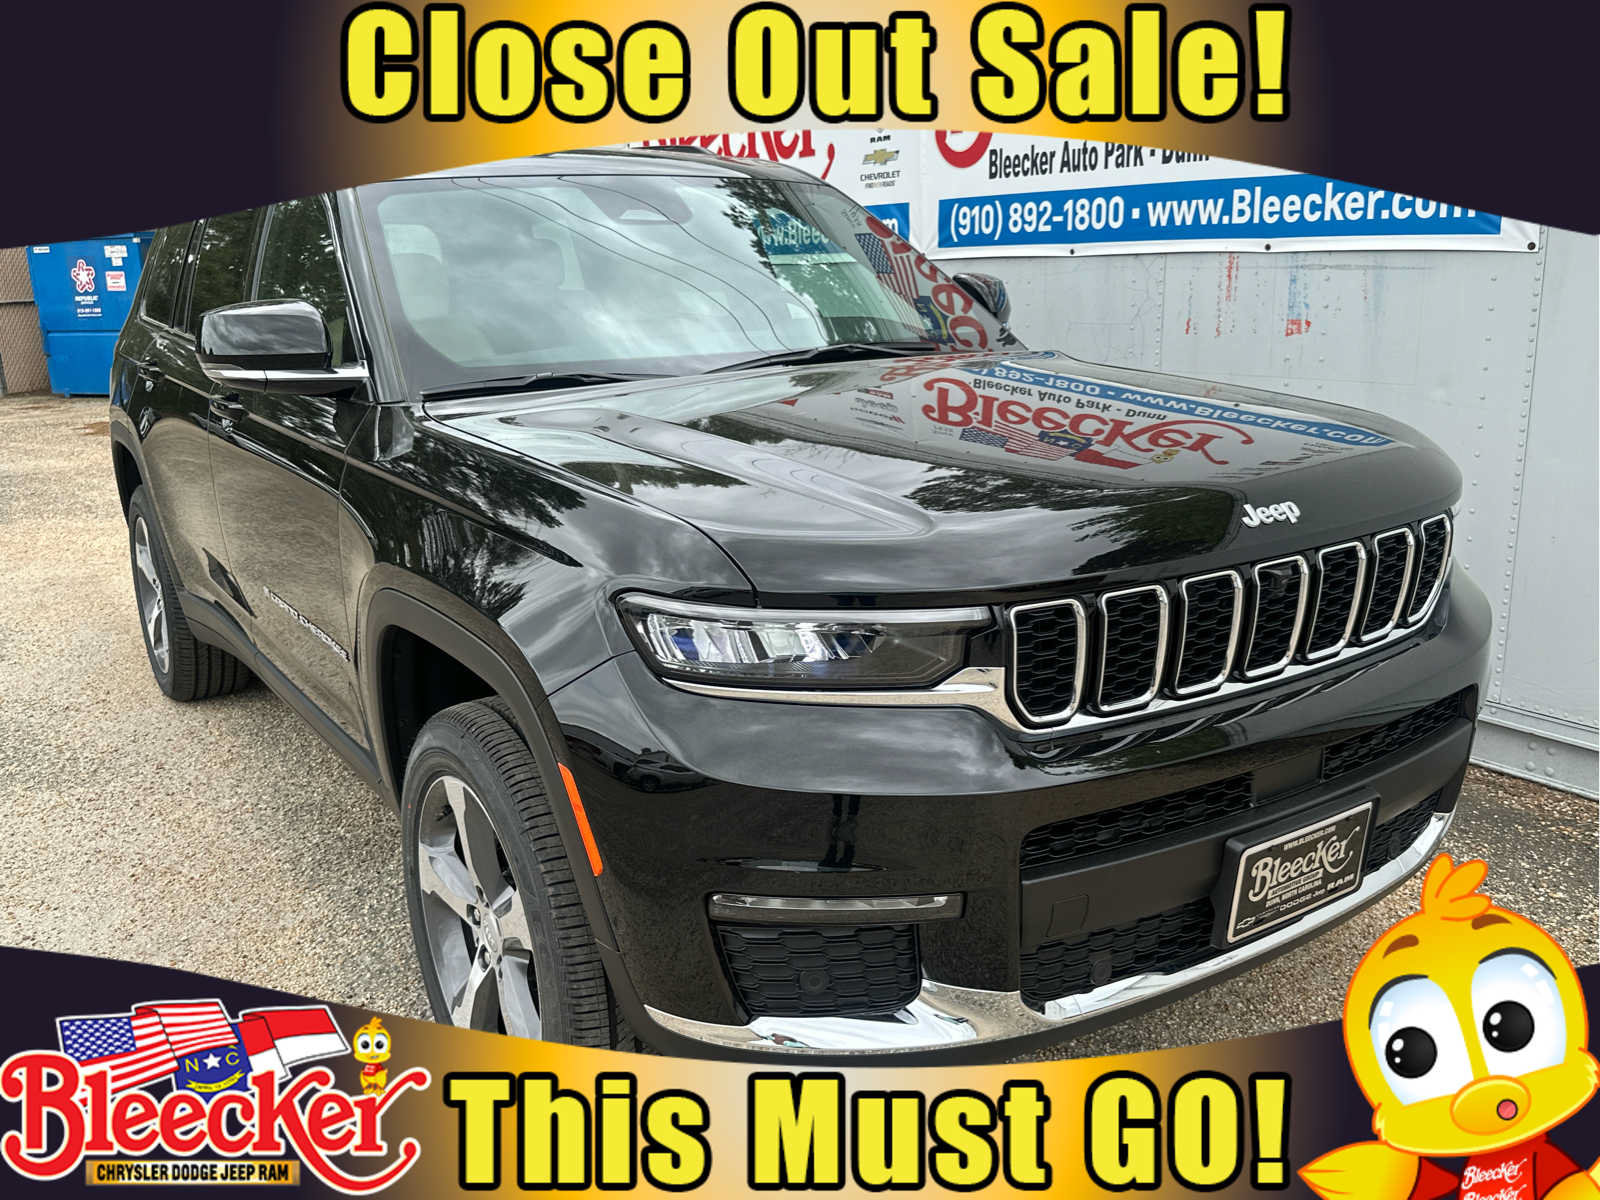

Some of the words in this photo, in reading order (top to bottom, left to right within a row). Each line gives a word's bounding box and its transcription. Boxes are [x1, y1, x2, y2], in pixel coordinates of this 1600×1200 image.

[870, 134, 891, 143] RAM
[988, 144, 1056, 180] Bleecker
[1059, 140, 1098, 174] Auto
[1104, 141, 1144, 170] Park
[860, 170, 901, 181] CHEVROLET
[950, 200, 1003, 242] (910)
[1008, 195, 1125, 233] 892-1800
[1241, 501, 1301, 527] Jeep
[1248, 825, 1360, 902] Bleecker
[1327, 873, 1354, 890] RAM
